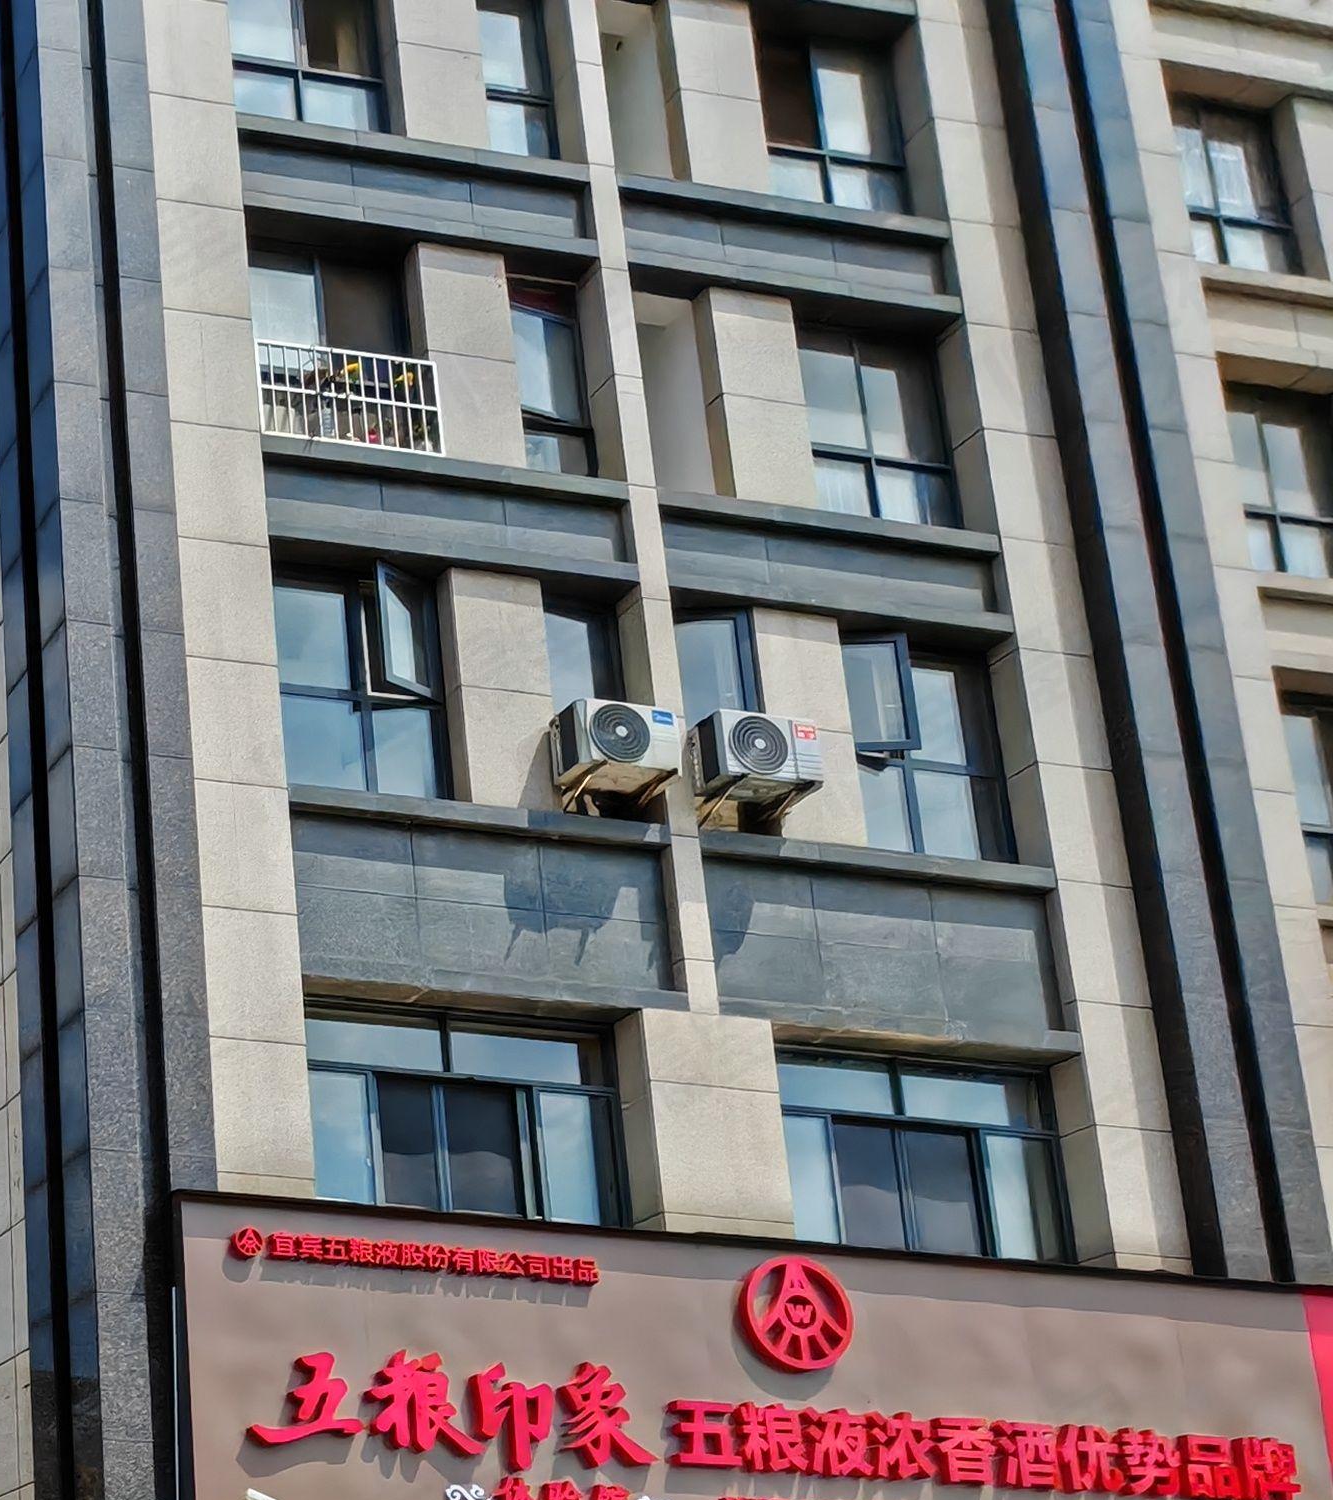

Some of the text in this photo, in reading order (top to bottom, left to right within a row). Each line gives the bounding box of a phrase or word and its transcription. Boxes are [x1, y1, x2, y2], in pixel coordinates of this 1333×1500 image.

[270, 1232, 600, 1286] 宜宾五粮液股份有限公司出品
[245, 1349, 659, 1472] 五粮印象
